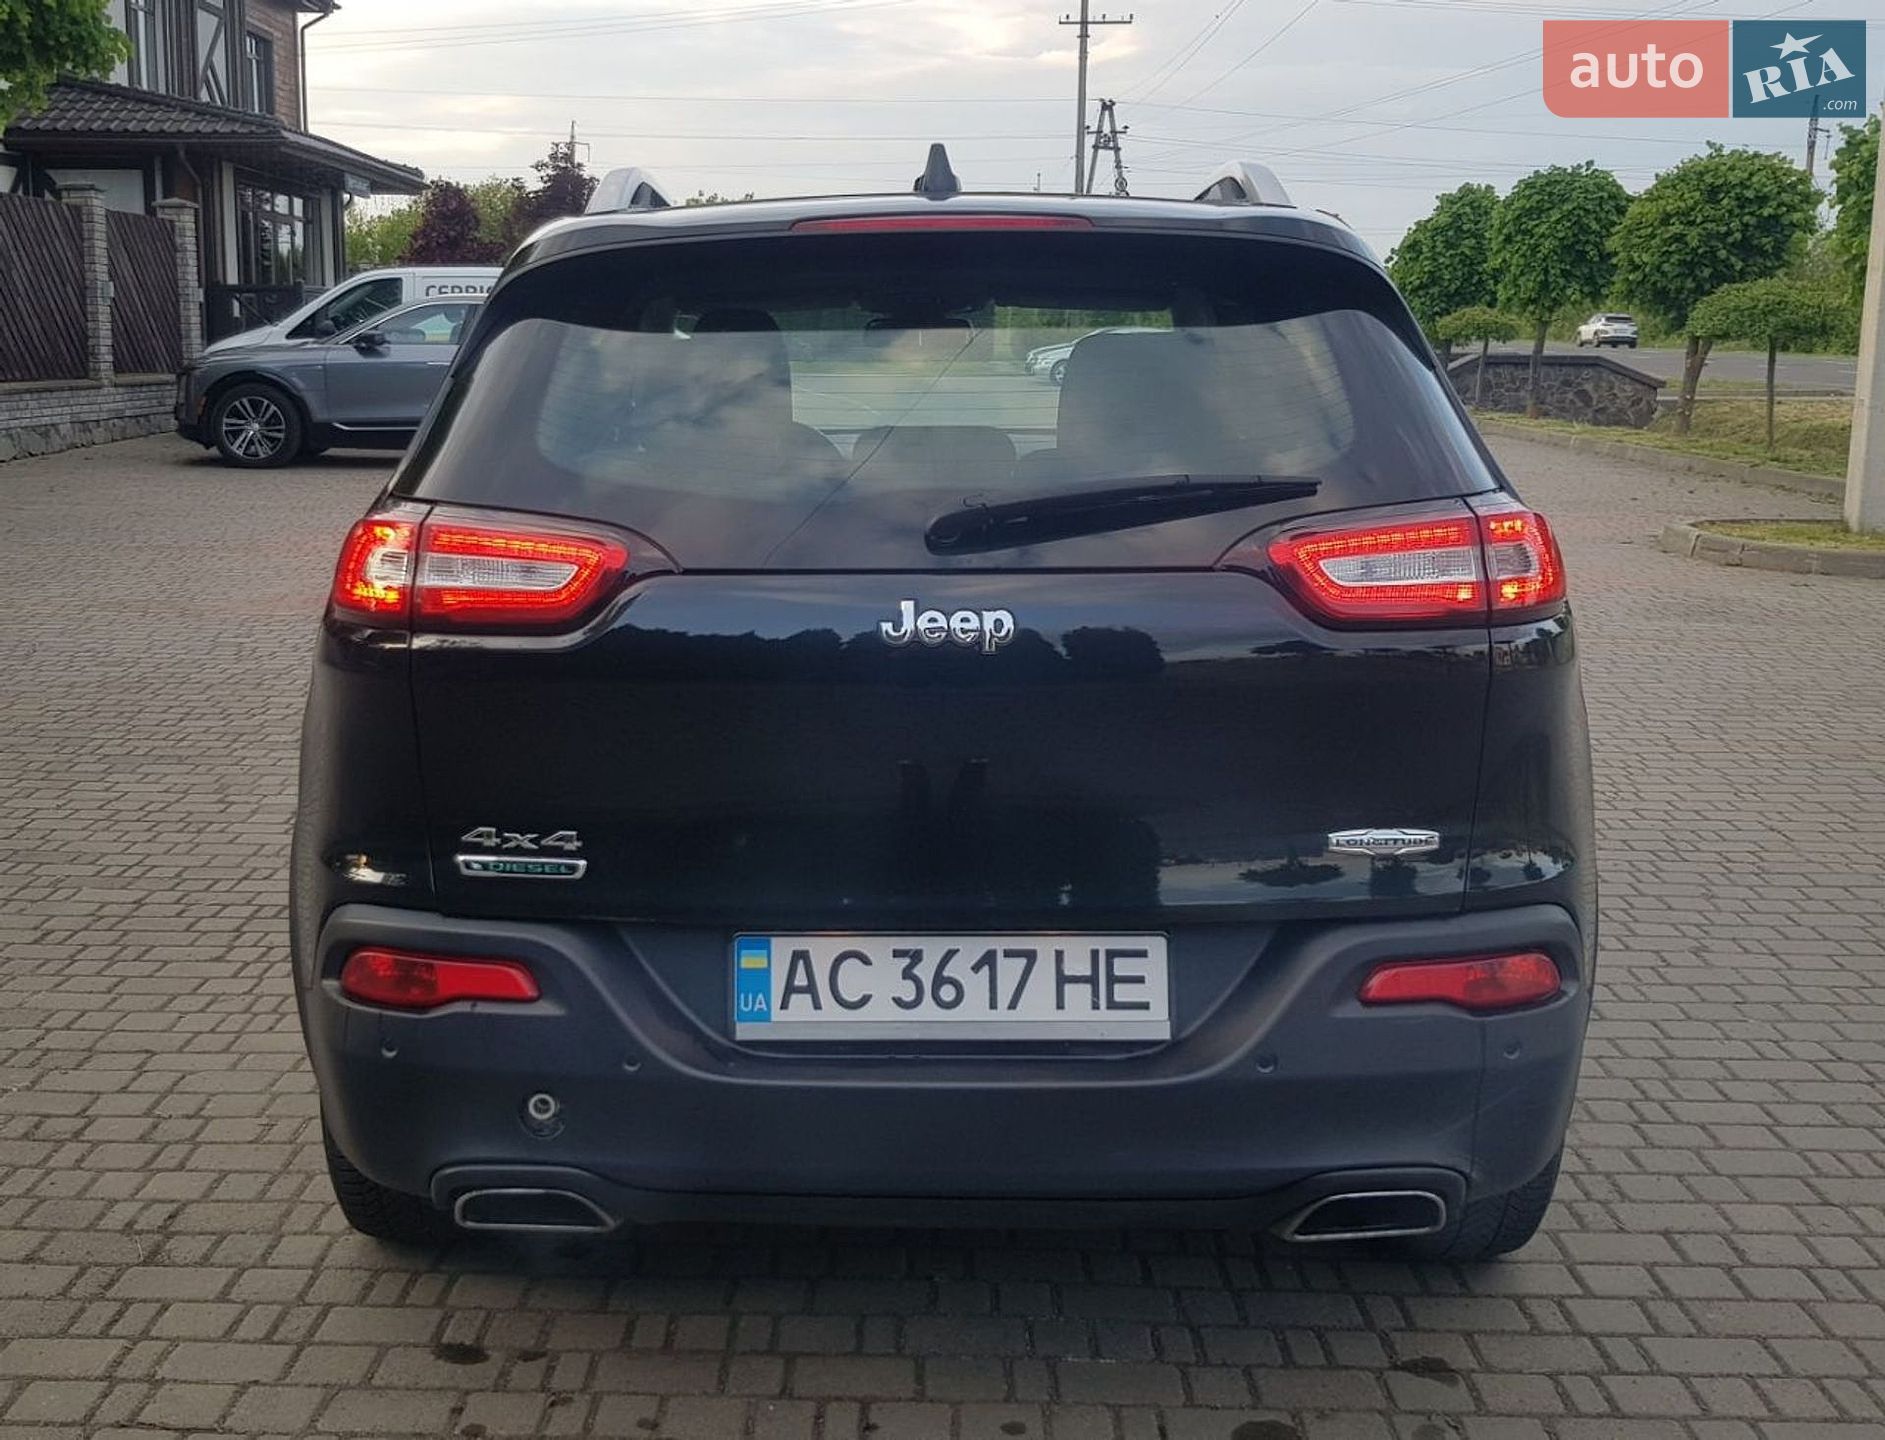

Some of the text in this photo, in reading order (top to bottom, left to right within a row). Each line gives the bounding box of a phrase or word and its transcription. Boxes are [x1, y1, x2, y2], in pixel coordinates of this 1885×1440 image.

[879, 600, 1015, 654] Jeep
[489, 860, 573, 873] DIESEL
[779, 948, 1151, 1010] AC 3617 HE
[740, 993, 768, 1012] UA
